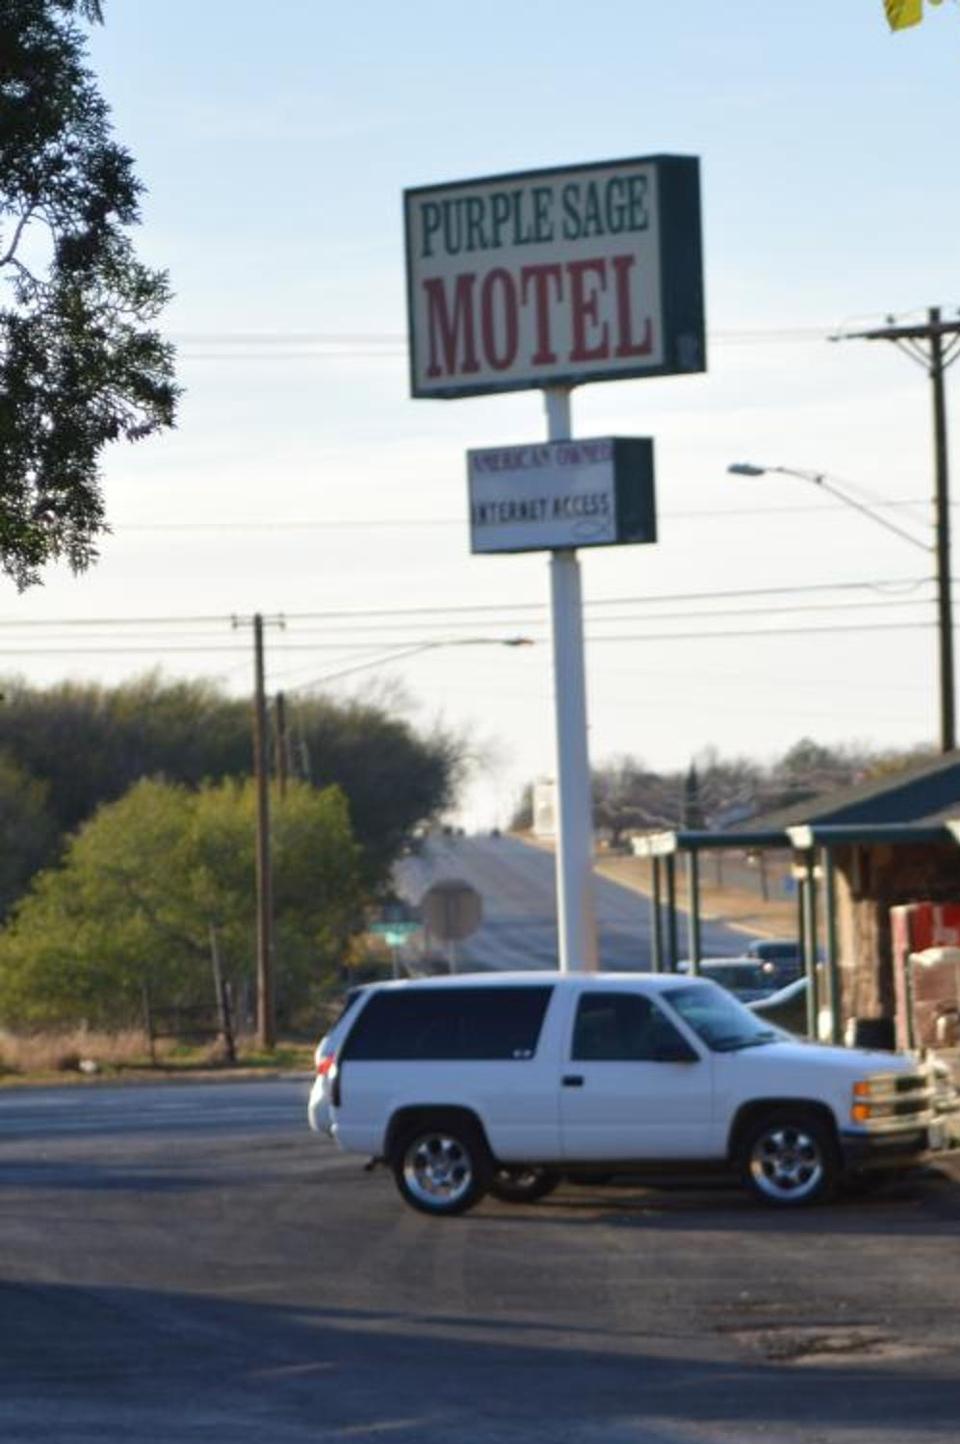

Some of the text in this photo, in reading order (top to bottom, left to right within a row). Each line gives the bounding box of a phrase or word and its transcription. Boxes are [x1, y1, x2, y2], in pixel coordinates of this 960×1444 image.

[420, 174, 648, 258] PURPLE SAGE
[422, 254, 653, 378] MOTEL
[553, 493, 609, 518] ACCESS
